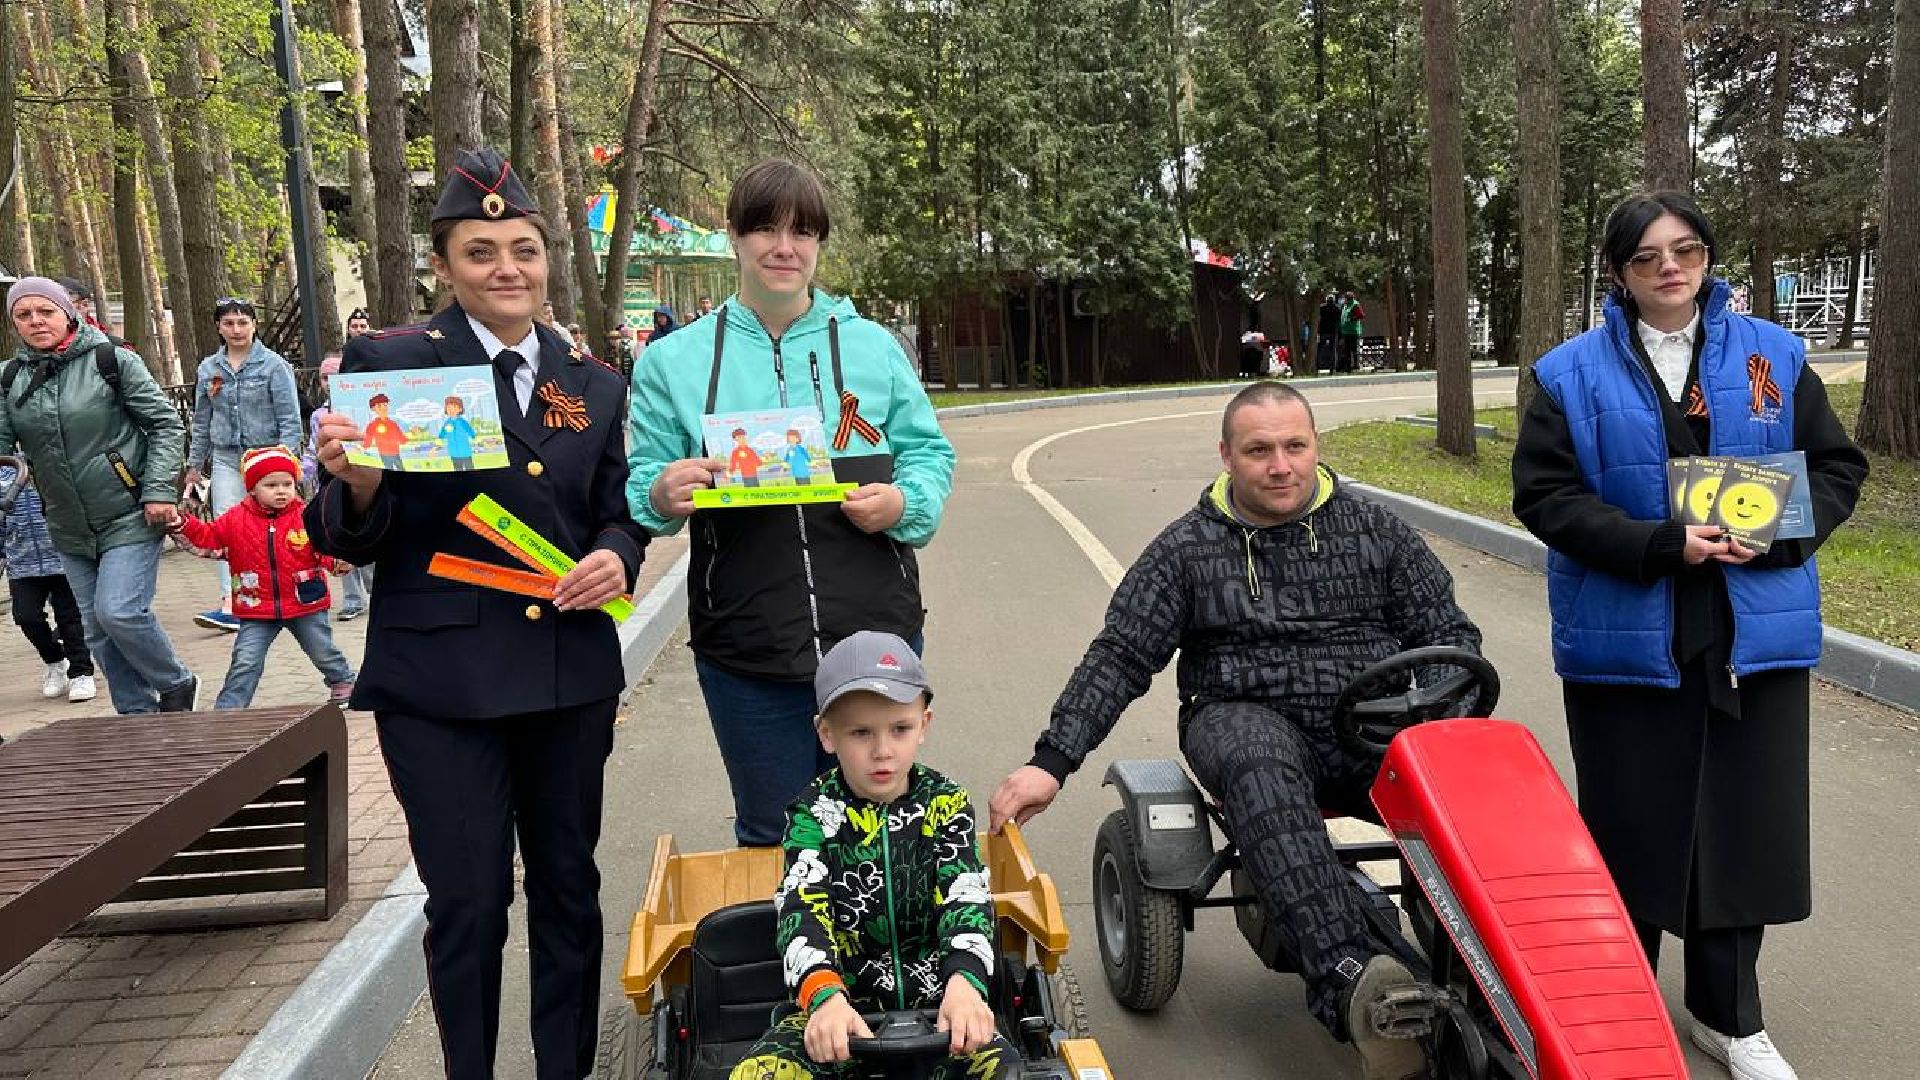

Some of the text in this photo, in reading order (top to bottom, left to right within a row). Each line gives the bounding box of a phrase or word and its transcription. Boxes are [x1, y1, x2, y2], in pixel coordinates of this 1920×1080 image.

[1283, 555, 1360, 583] HUMAN
[1316, 578, 1365, 599] STATE
[1461, 935, 1501, 995] SPORT
